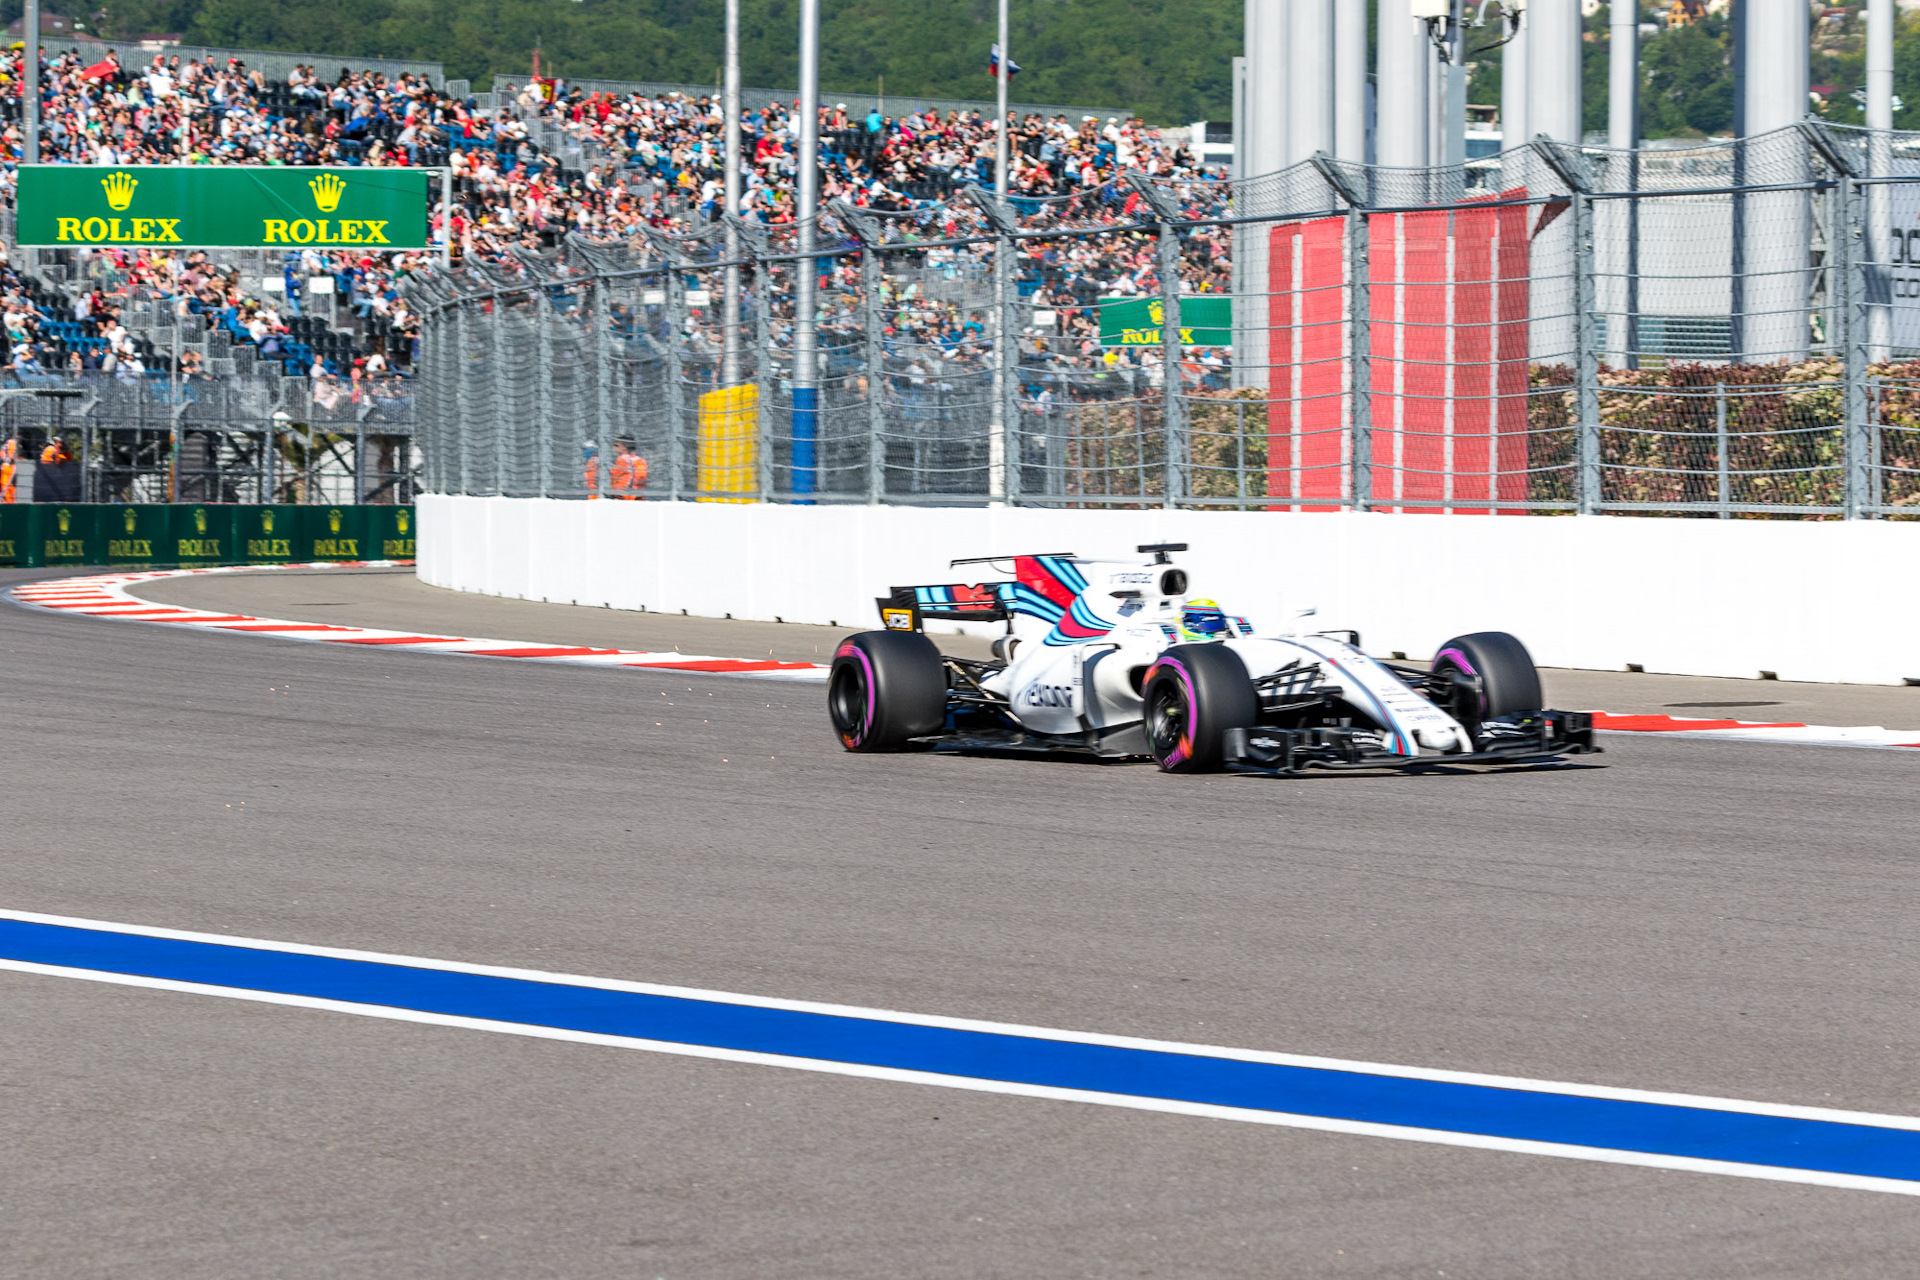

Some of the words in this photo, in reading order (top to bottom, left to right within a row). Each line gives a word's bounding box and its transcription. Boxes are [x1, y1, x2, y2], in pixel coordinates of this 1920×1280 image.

[56, 216, 183, 243] ROLEX
[262, 218, 391, 244] ROLEX
[1121, 328, 1195, 344] ROLX
[45, 540, 84, 556] ROLEX
[108, 540, 152, 556] ROLEX
[178, 539, 220, 556] ROLEX
[247, 539, 291, 556] ROLEX
[313, 539, 359, 556] ROLEX
[383, 539, 416, 556] ROLE
